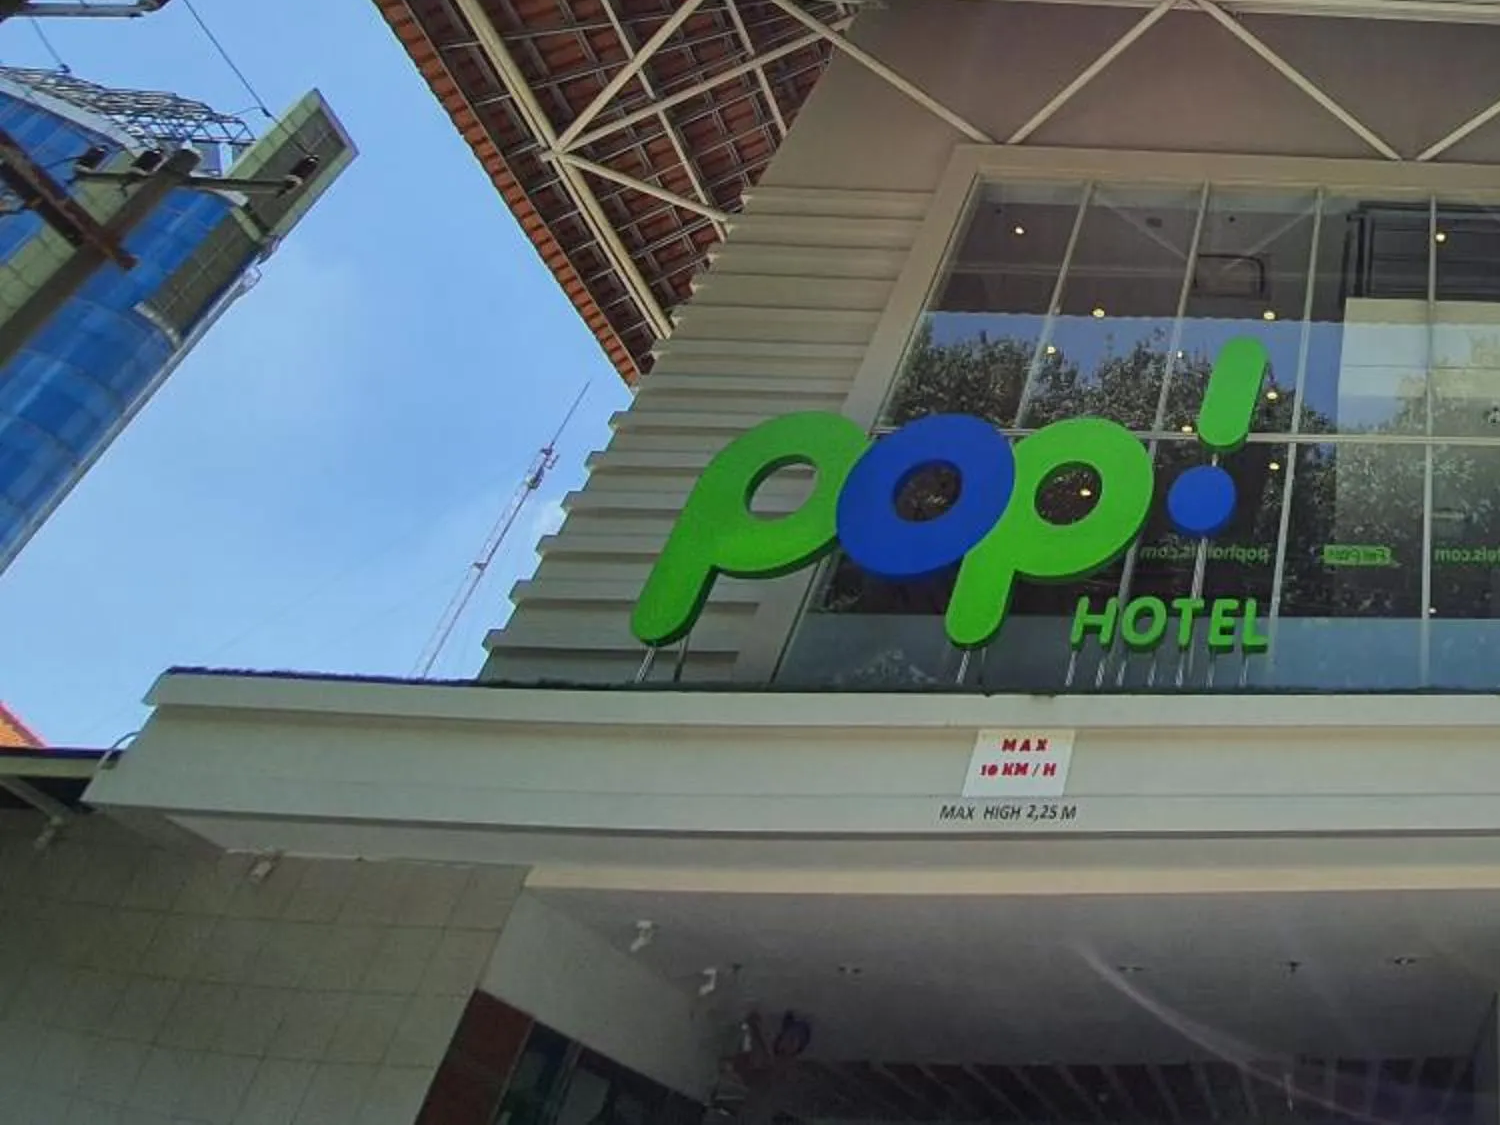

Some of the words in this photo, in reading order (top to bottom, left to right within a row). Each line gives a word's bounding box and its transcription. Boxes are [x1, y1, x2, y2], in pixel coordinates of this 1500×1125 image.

[1069, 595, 1270, 653] HOTEL
[1001, 738, 1049, 752] MAX
[981, 764, 999, 777] 10
[939, 804, 976, 821] MAX
[983, 805, 1022, 821] HIGH
[1026, 804, 1058, 822] 2,25
[1060, 805, 1077, 821] M
